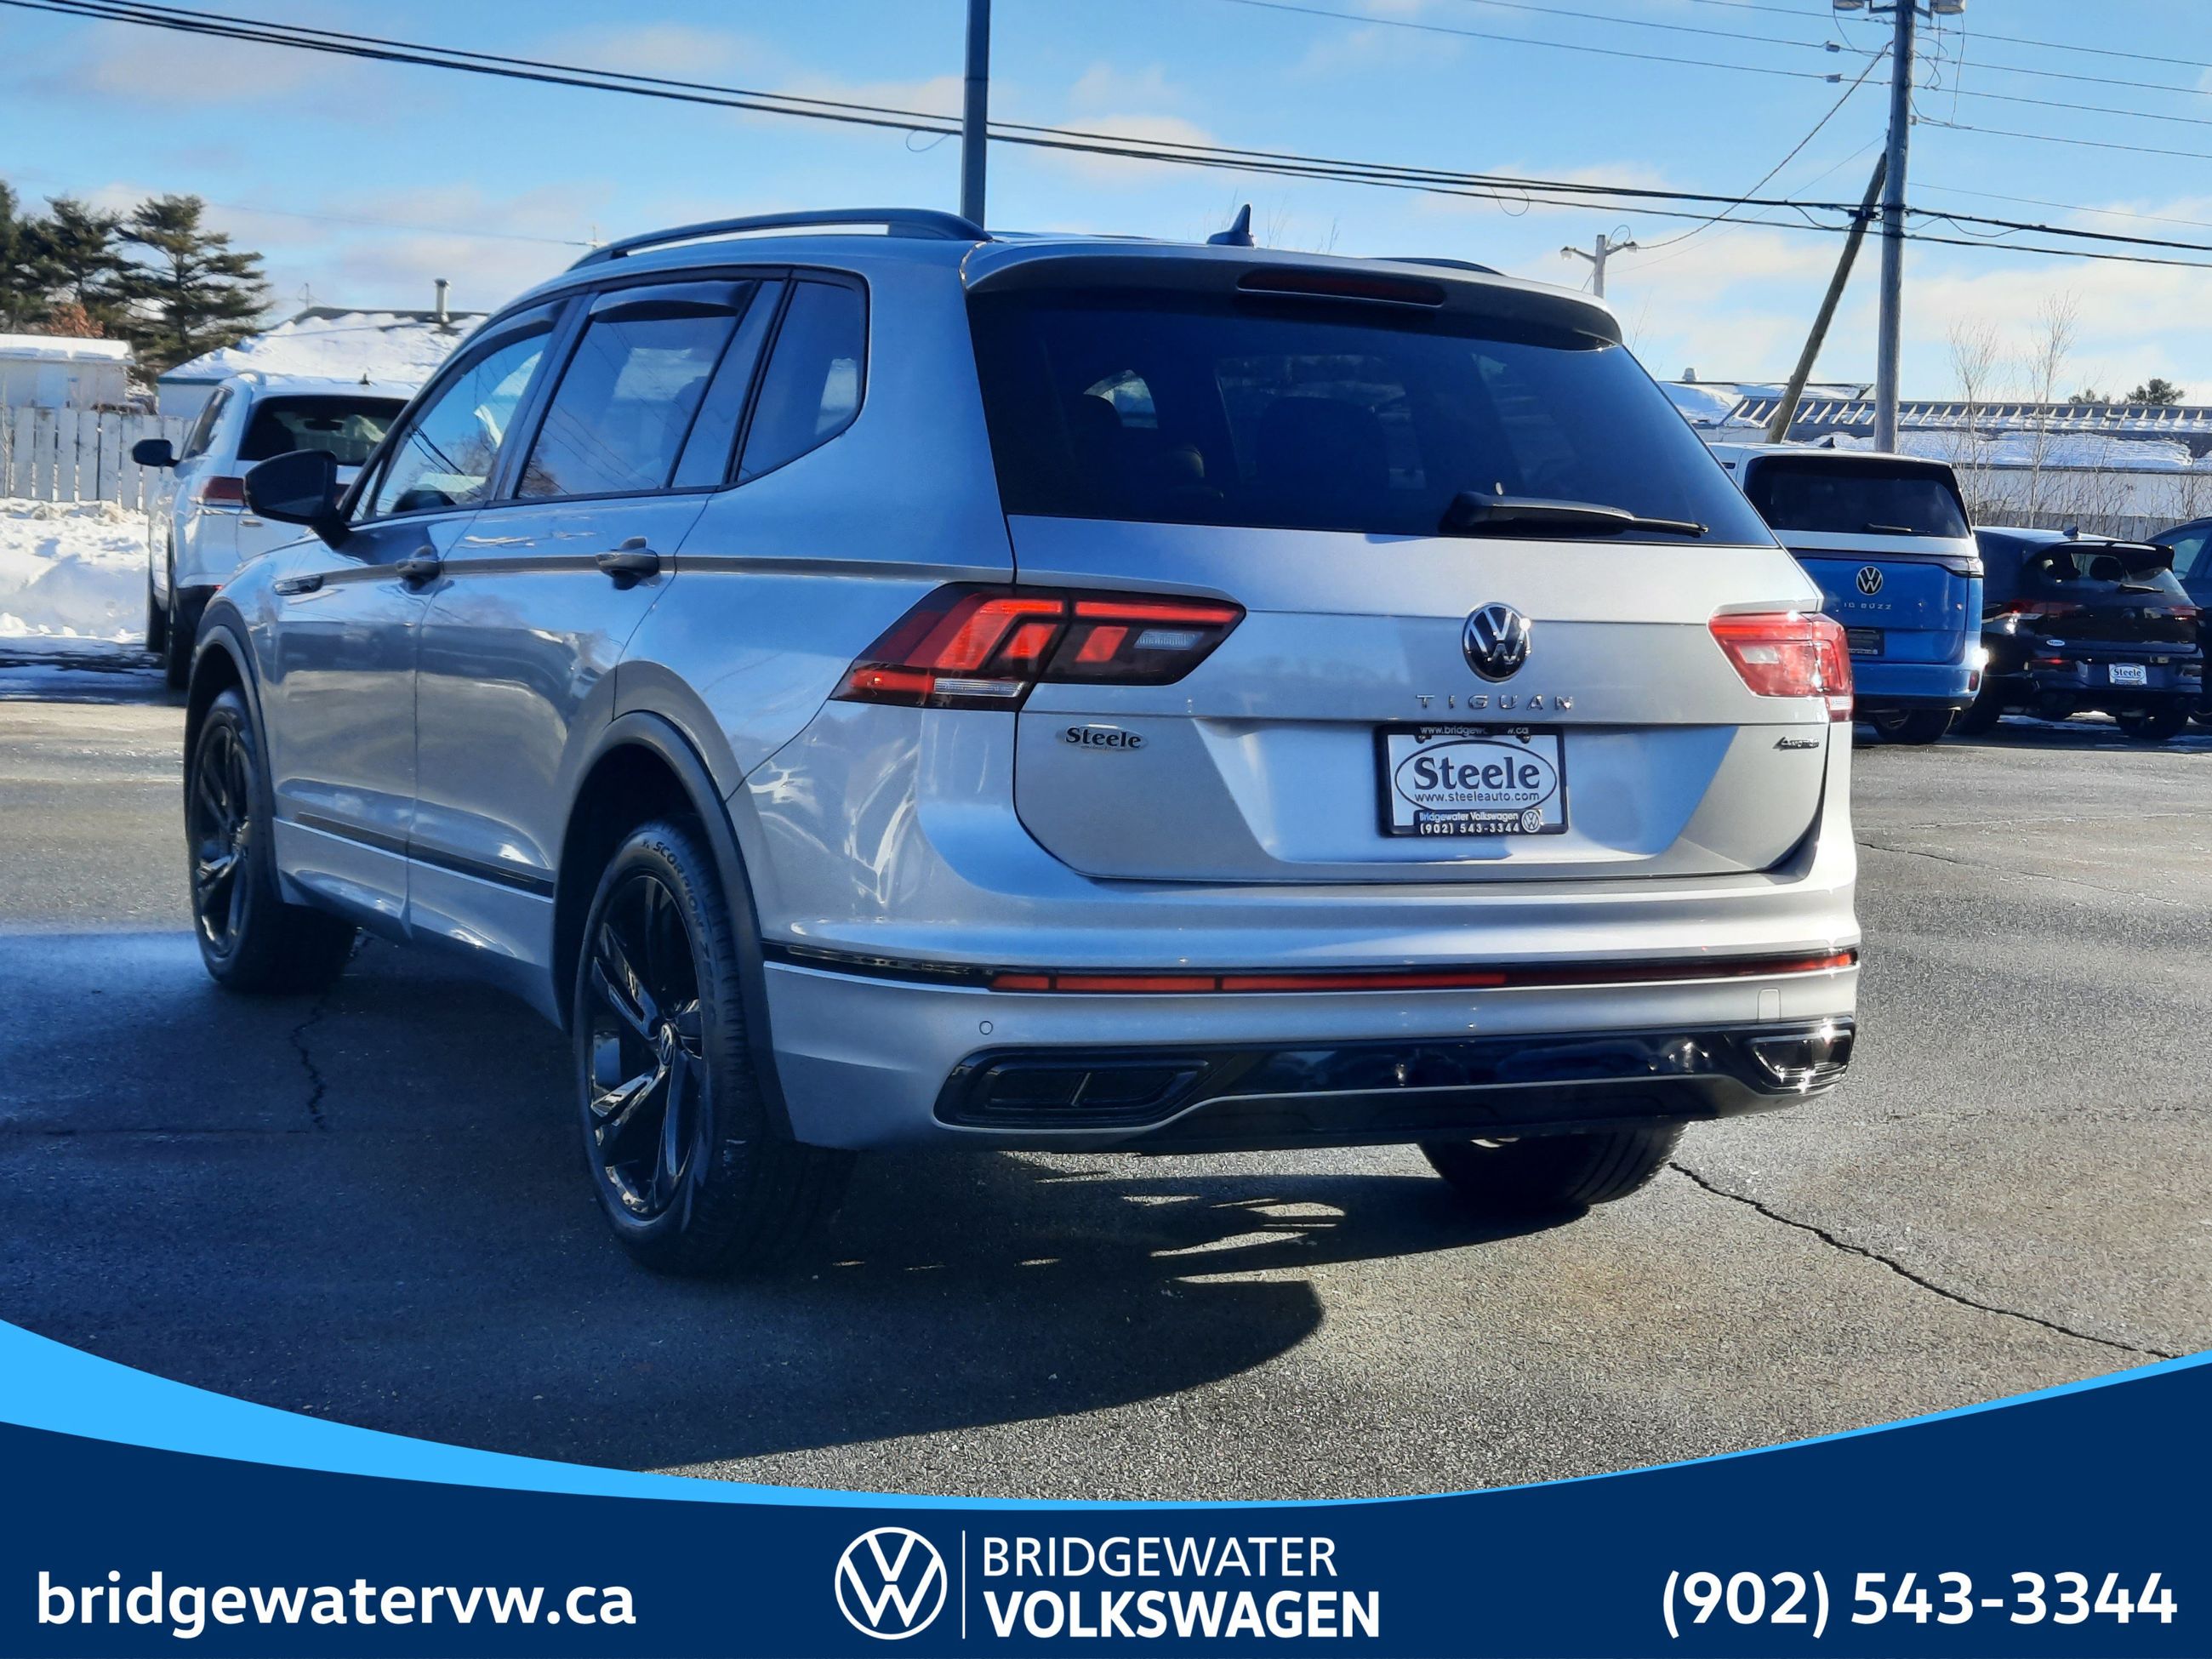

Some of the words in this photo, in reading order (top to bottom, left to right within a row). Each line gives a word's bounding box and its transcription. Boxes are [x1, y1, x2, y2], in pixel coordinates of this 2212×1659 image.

[1416, 694, 1573, 710] TIGUAN
[1065, 727, 1141, 749] Steele
[1414, 756, 1540, 790] Steele
[1415, 791, 1540, 801] www.steeleauto.com
[1419, 812, 1468, 823] Bridgewater
[1470, 812, 1519, 822] Volkswagen
[1420, 823, 1454, 835] (902)
[1459, 823, 1519, 834] 543-3344
